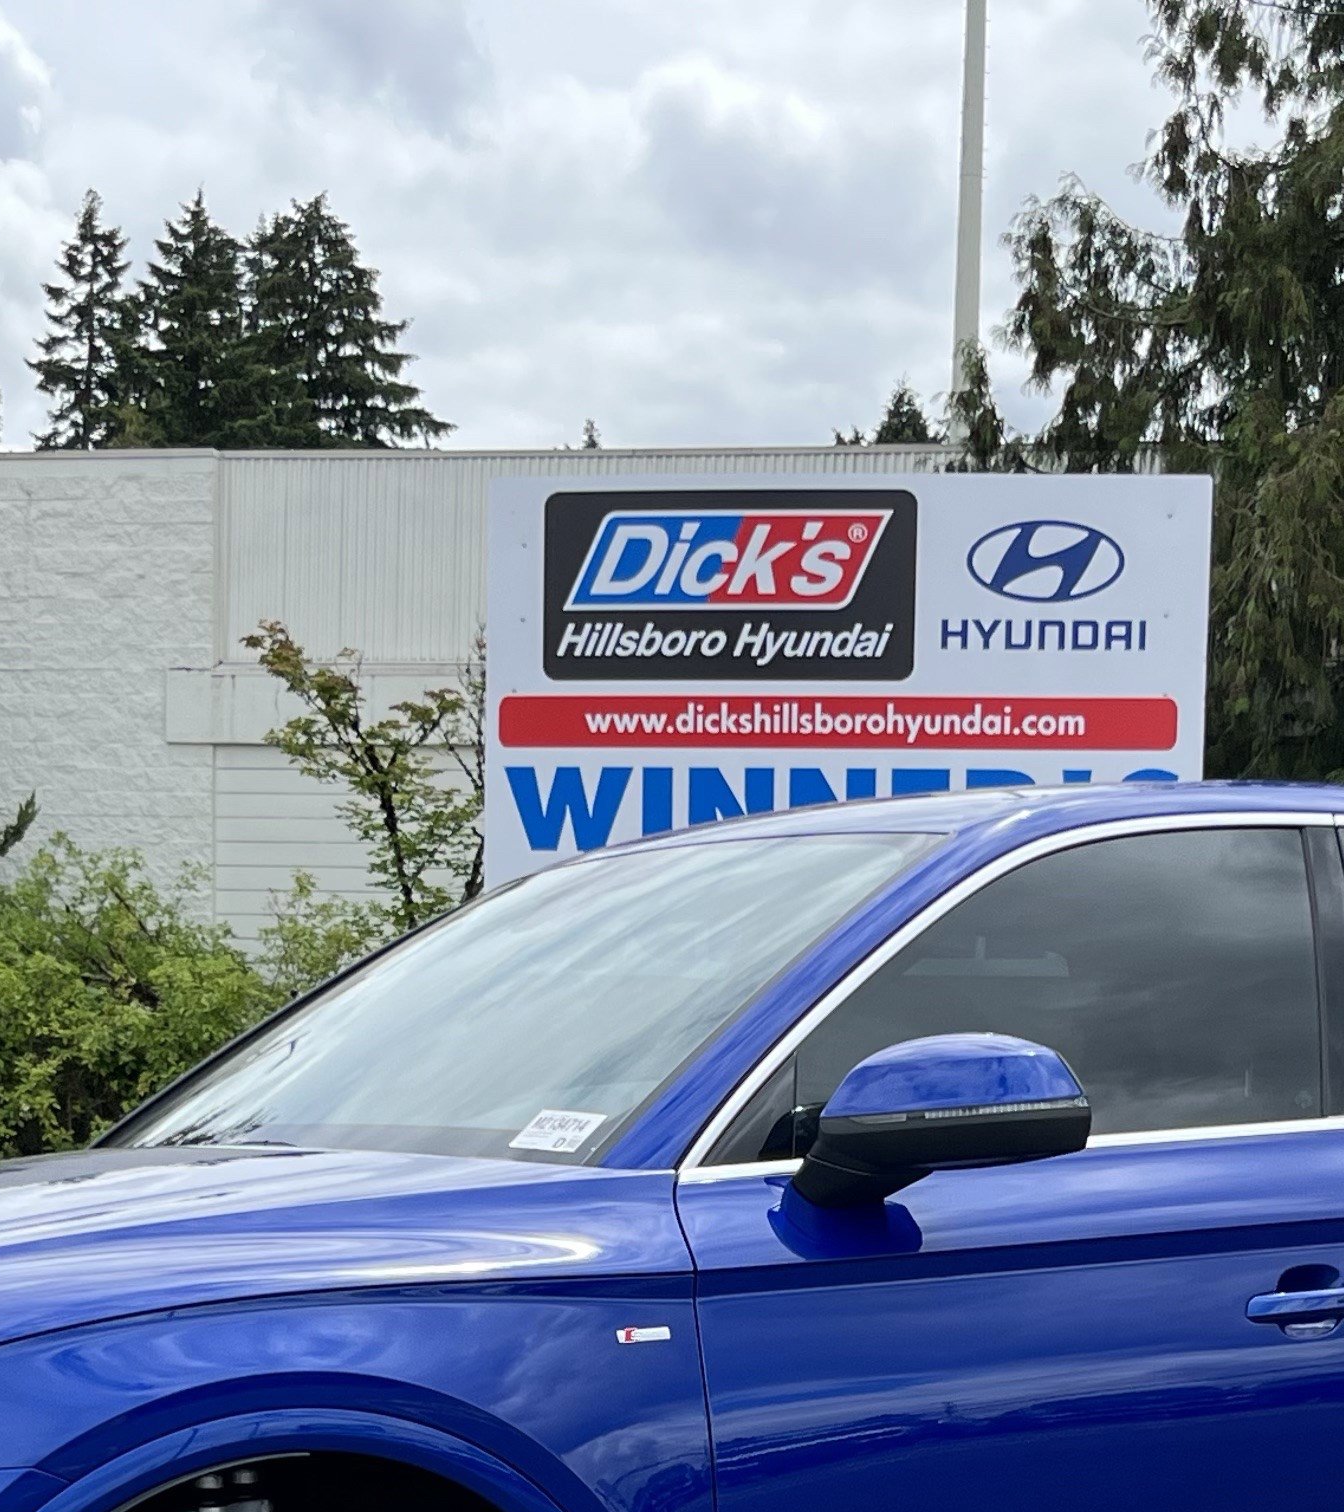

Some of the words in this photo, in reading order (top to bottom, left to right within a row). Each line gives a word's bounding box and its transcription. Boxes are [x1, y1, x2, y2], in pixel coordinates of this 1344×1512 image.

[590, 522, 850, 596] Dick's
[556, 622, 727, 658] Hillsboro
[733, 622, 894, 666] Hyundai
[940, 618, 1147, 651] HYUNDAI
[584, 702, 1086, 744] www.dickshillsborohyundai.com
